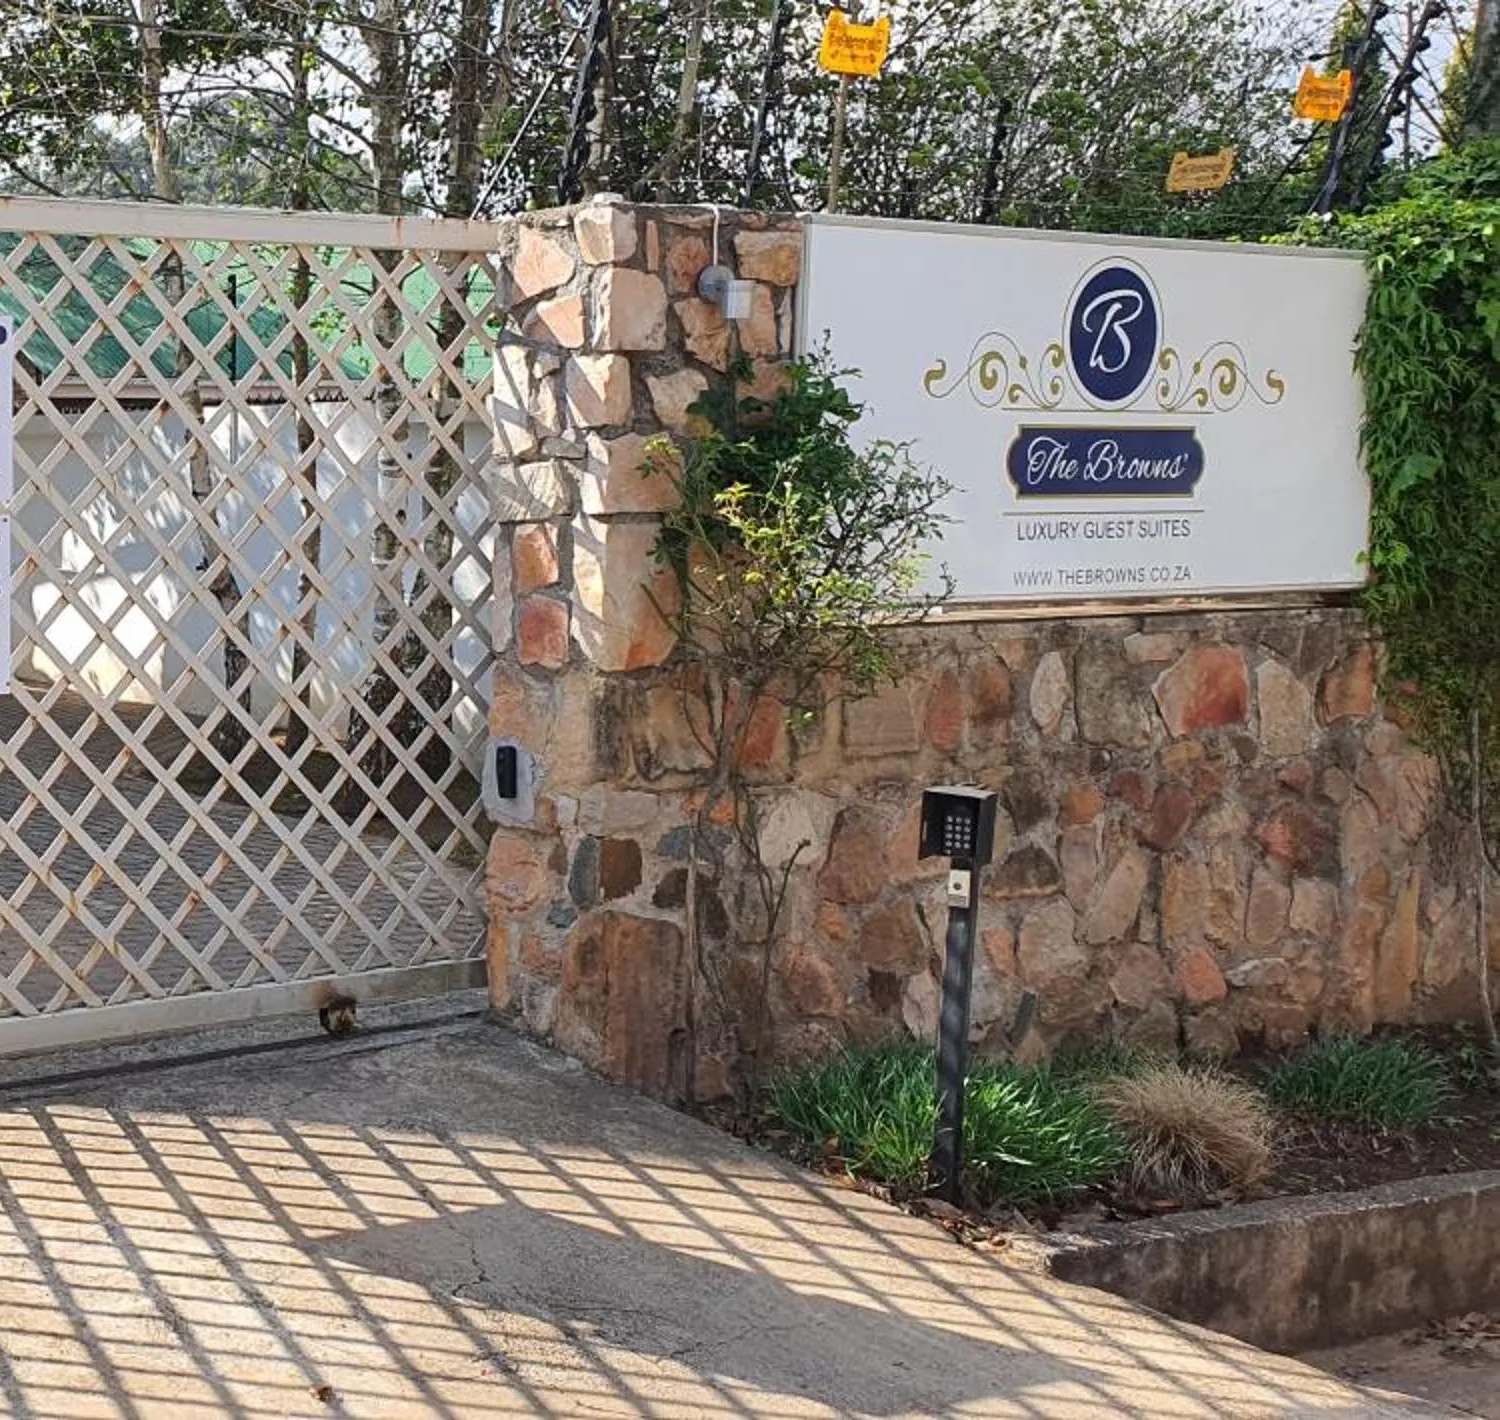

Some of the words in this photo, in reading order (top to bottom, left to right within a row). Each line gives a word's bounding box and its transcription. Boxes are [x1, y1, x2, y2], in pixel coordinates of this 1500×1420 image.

[1081, 288, 1144, 374] B
[1026, 435, 1079, 486] The
[1016, 520, 1079, 541] LUXURY
[1083, 520, 1135, 540] GUEST
[1138, 519, 1191, 538] SUITES
